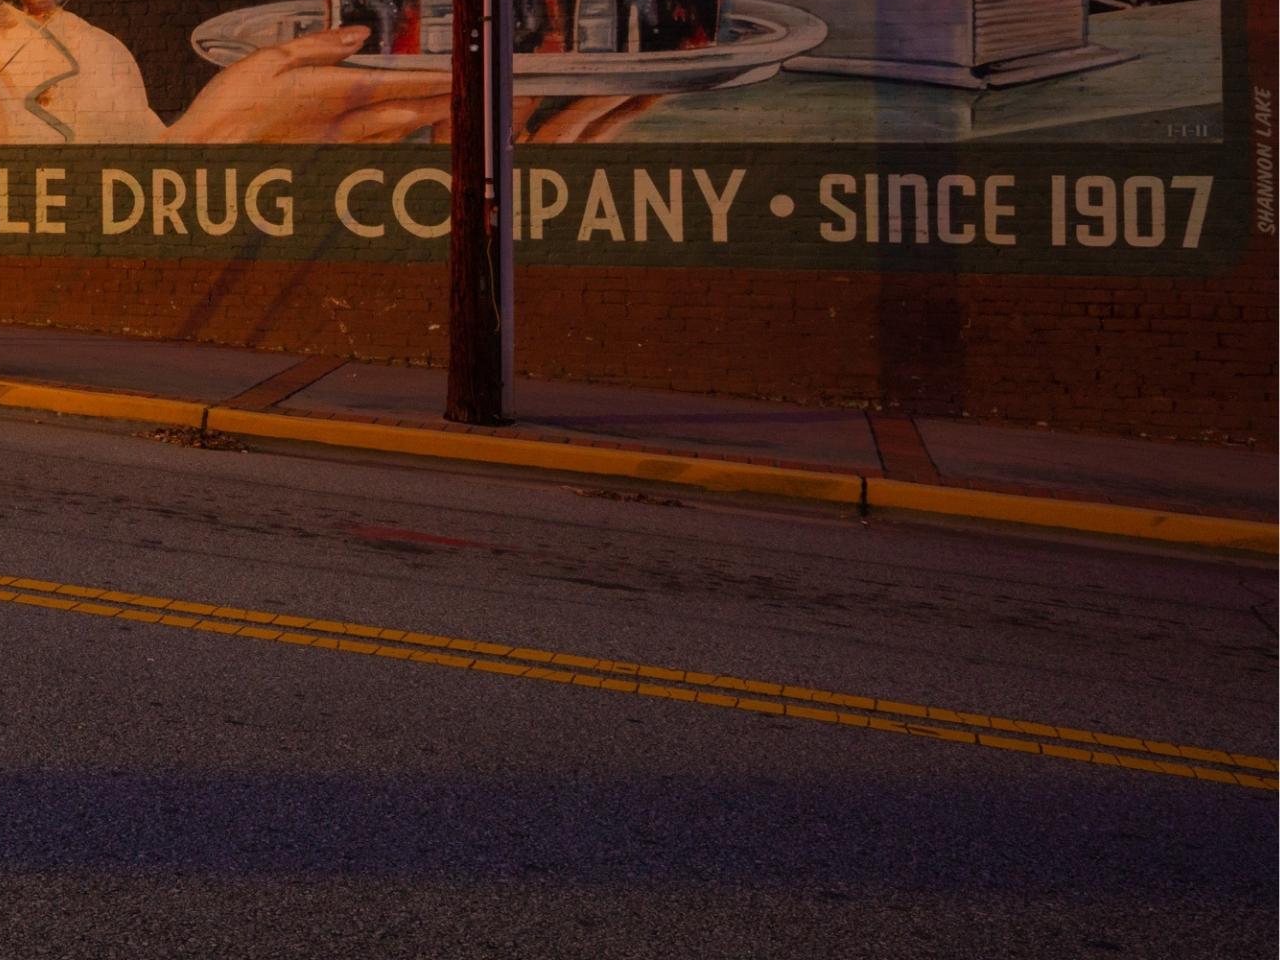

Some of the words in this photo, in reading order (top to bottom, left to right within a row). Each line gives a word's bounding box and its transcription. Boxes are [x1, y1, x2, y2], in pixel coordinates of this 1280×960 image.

[1253, 86, 1274, 137] LAKE
[101, 168, 295, 237] DRUG
[819, 172, 1017, 247] SINCE
[1051, 174, 1214, 249] 1907
[1256, 141, 1277, 236] SHANNON
